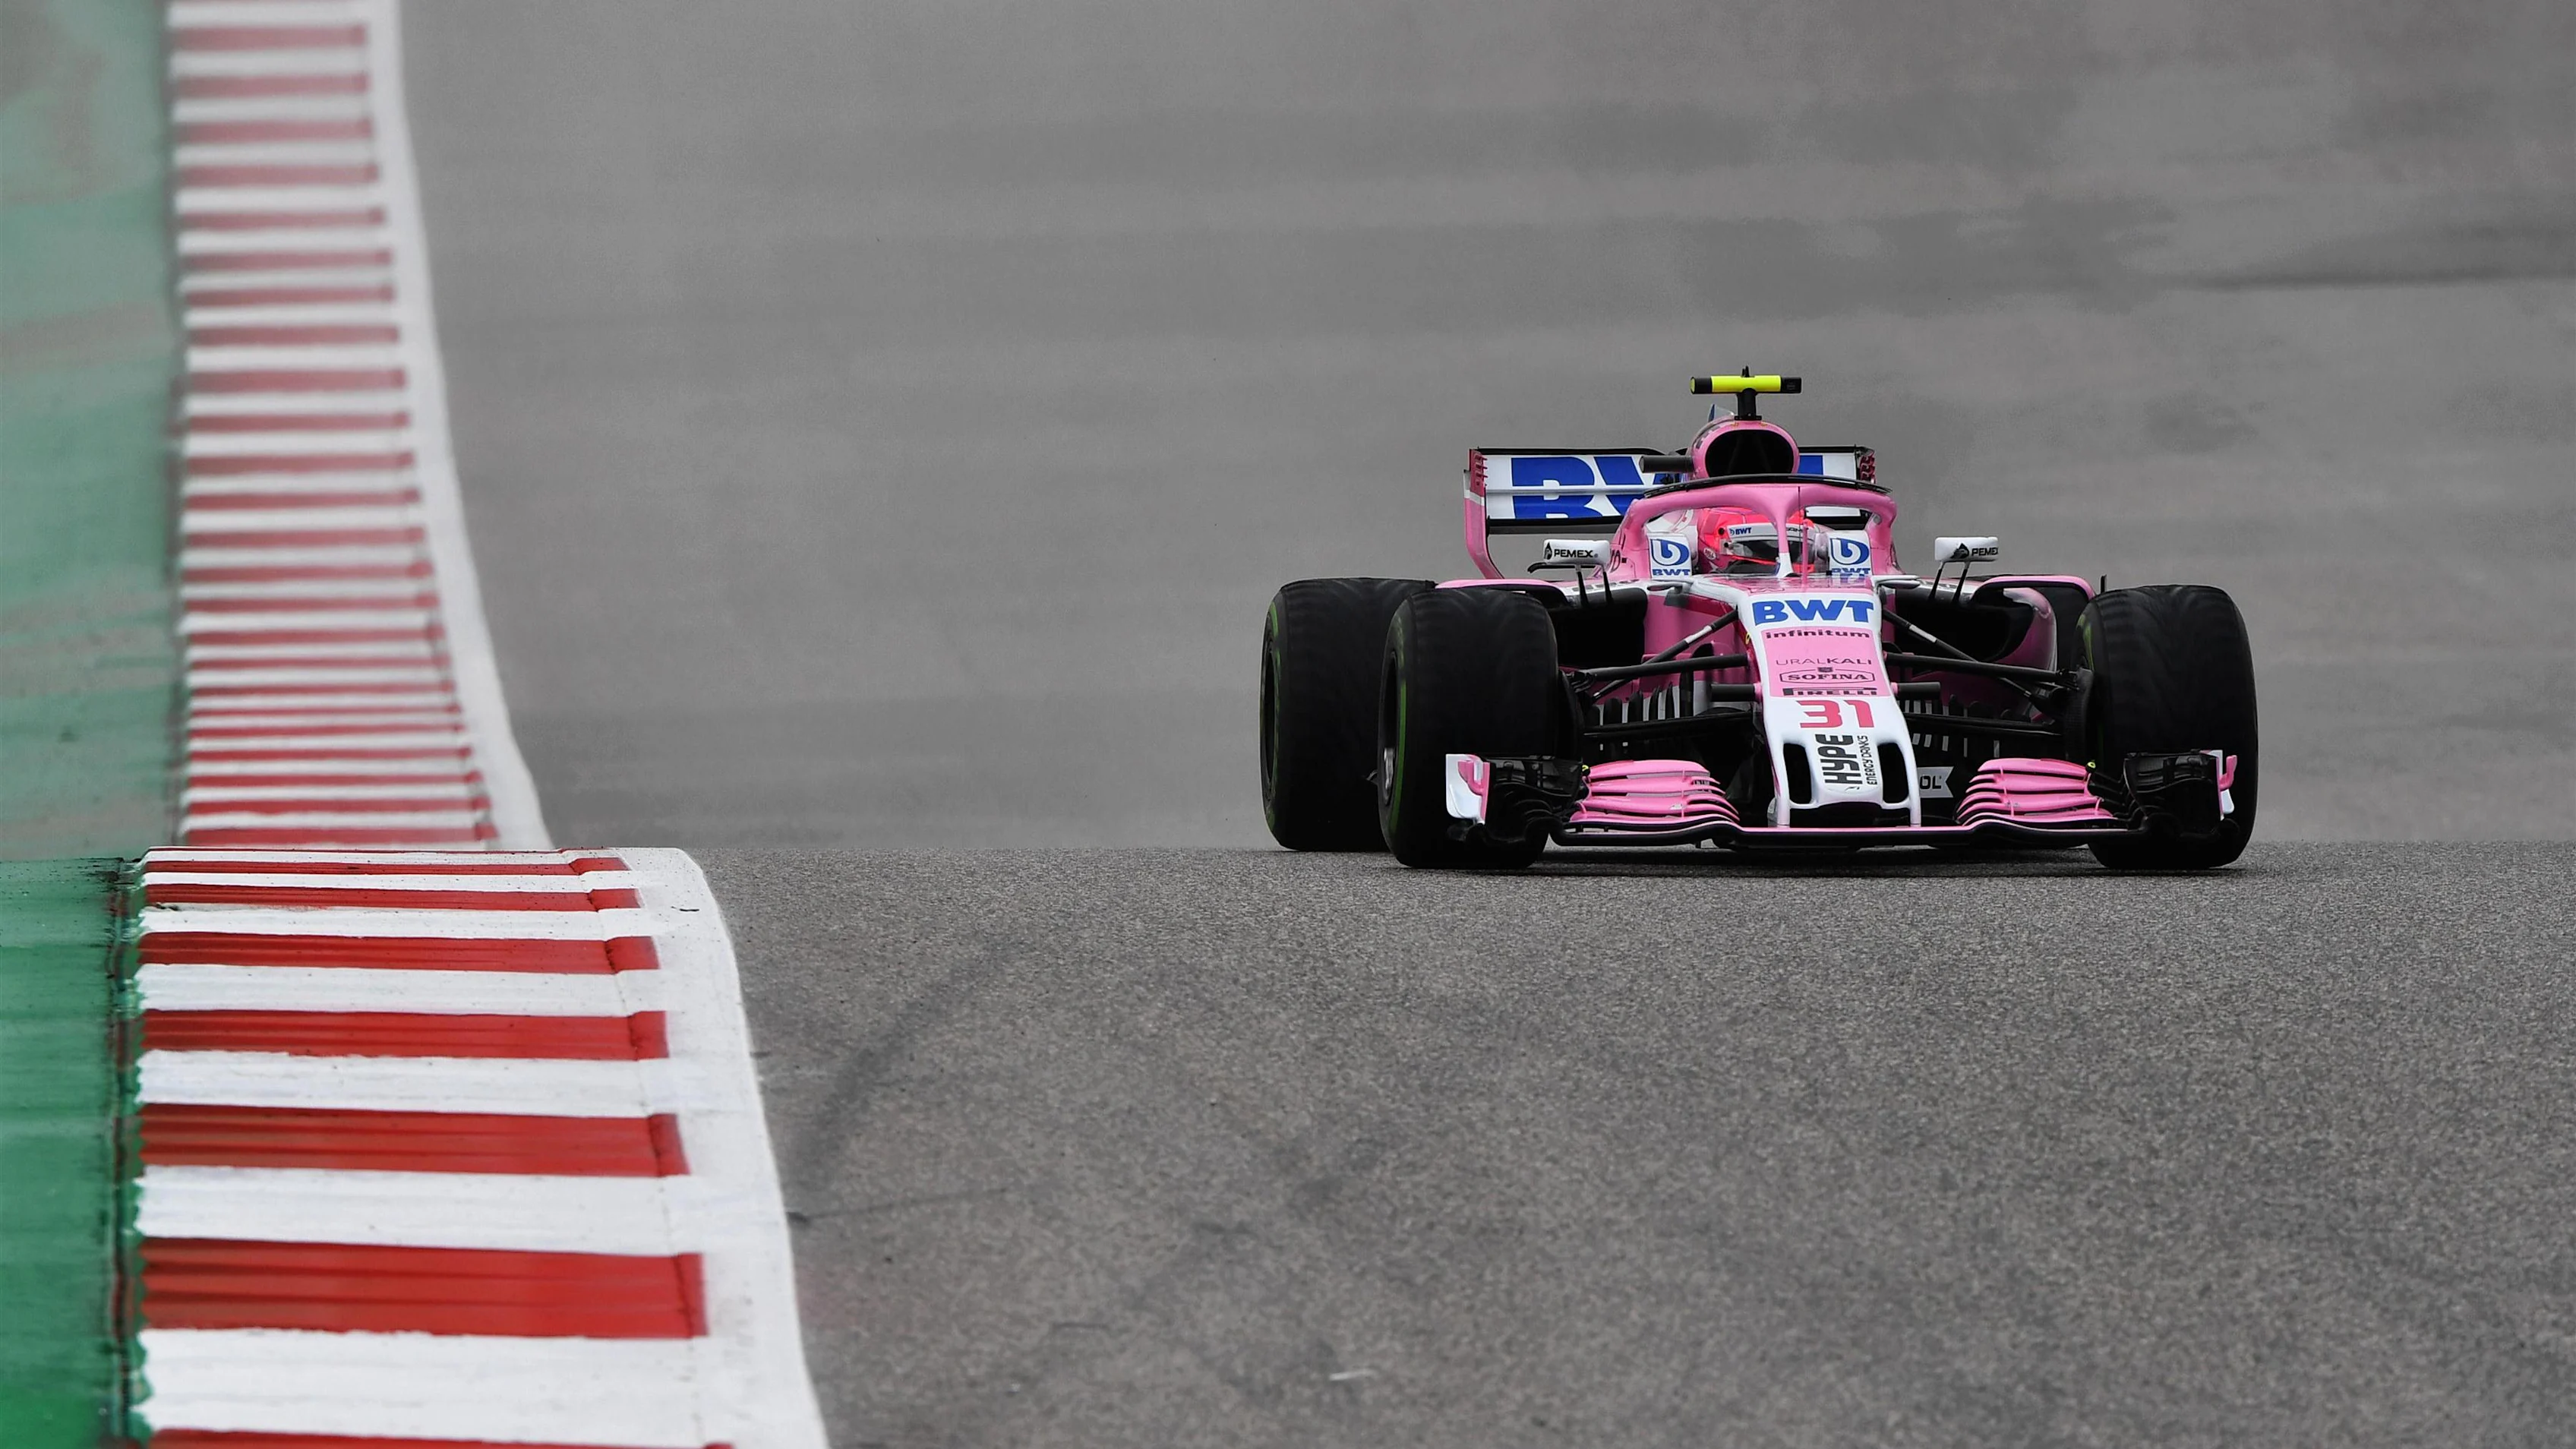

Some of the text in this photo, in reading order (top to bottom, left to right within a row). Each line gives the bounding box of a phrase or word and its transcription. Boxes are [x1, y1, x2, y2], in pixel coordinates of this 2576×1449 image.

[1554, 549, 1593, 558] PEMEX
[1752, 600, 1874, 626] BWT
[1766, 630, 1870, 639] infinitum
[1796, 699, 1874, 728] 31
[1815, 734, 1863, 784] HYPE
[1862, 759, 1877, 784] ENERGY
